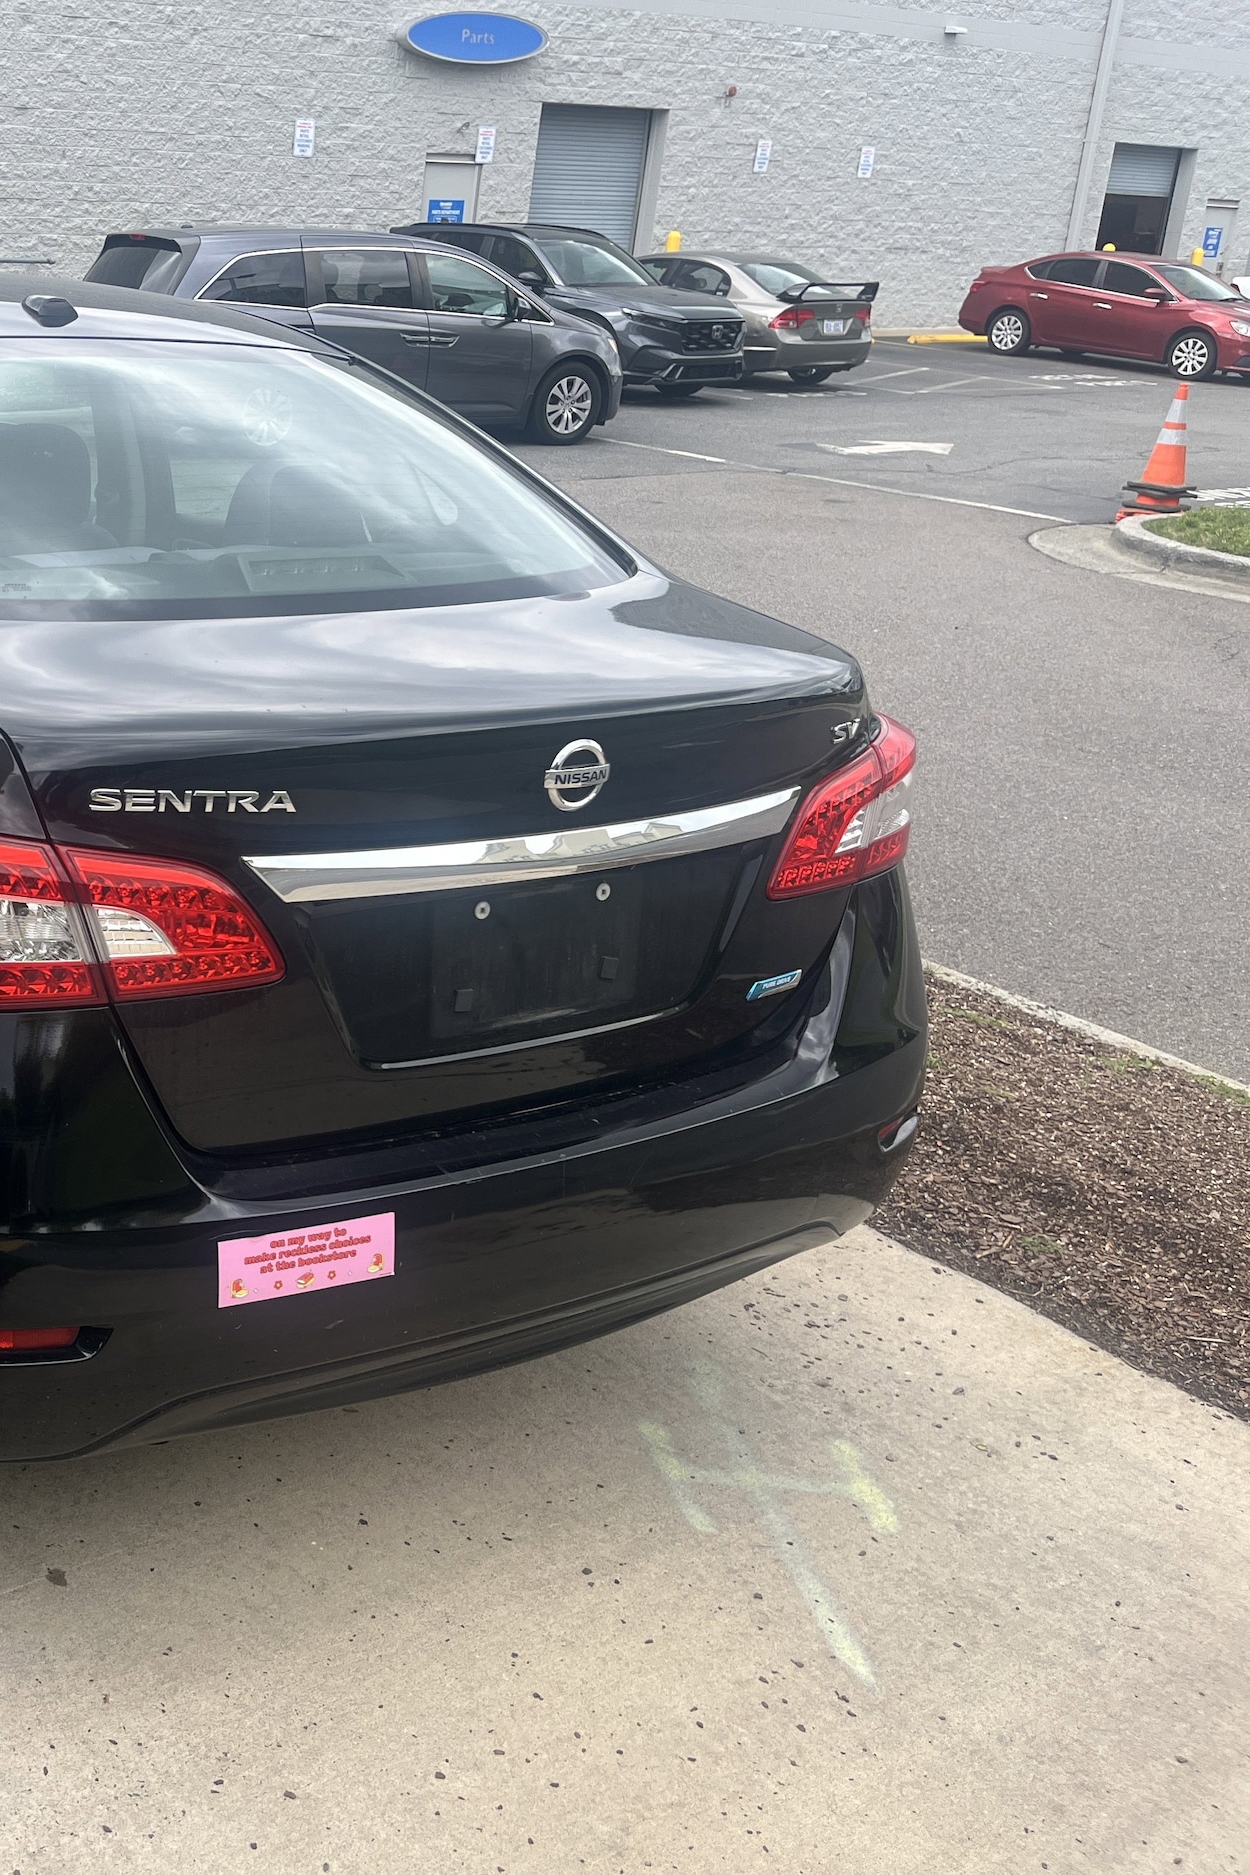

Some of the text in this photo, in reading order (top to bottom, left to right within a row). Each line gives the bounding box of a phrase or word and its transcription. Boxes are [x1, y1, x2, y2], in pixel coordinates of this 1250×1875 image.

[462, 28, 494, 44] Parts
[554, 769, 607, 785] NISSAN
[88, 788, 297, 813] SENTRA
[270, 1228, 347, 1248] on my way to
[244, 1235, 371, 1264] make reckless choices
[260, 1250, 357, 1274] at the bookstore
